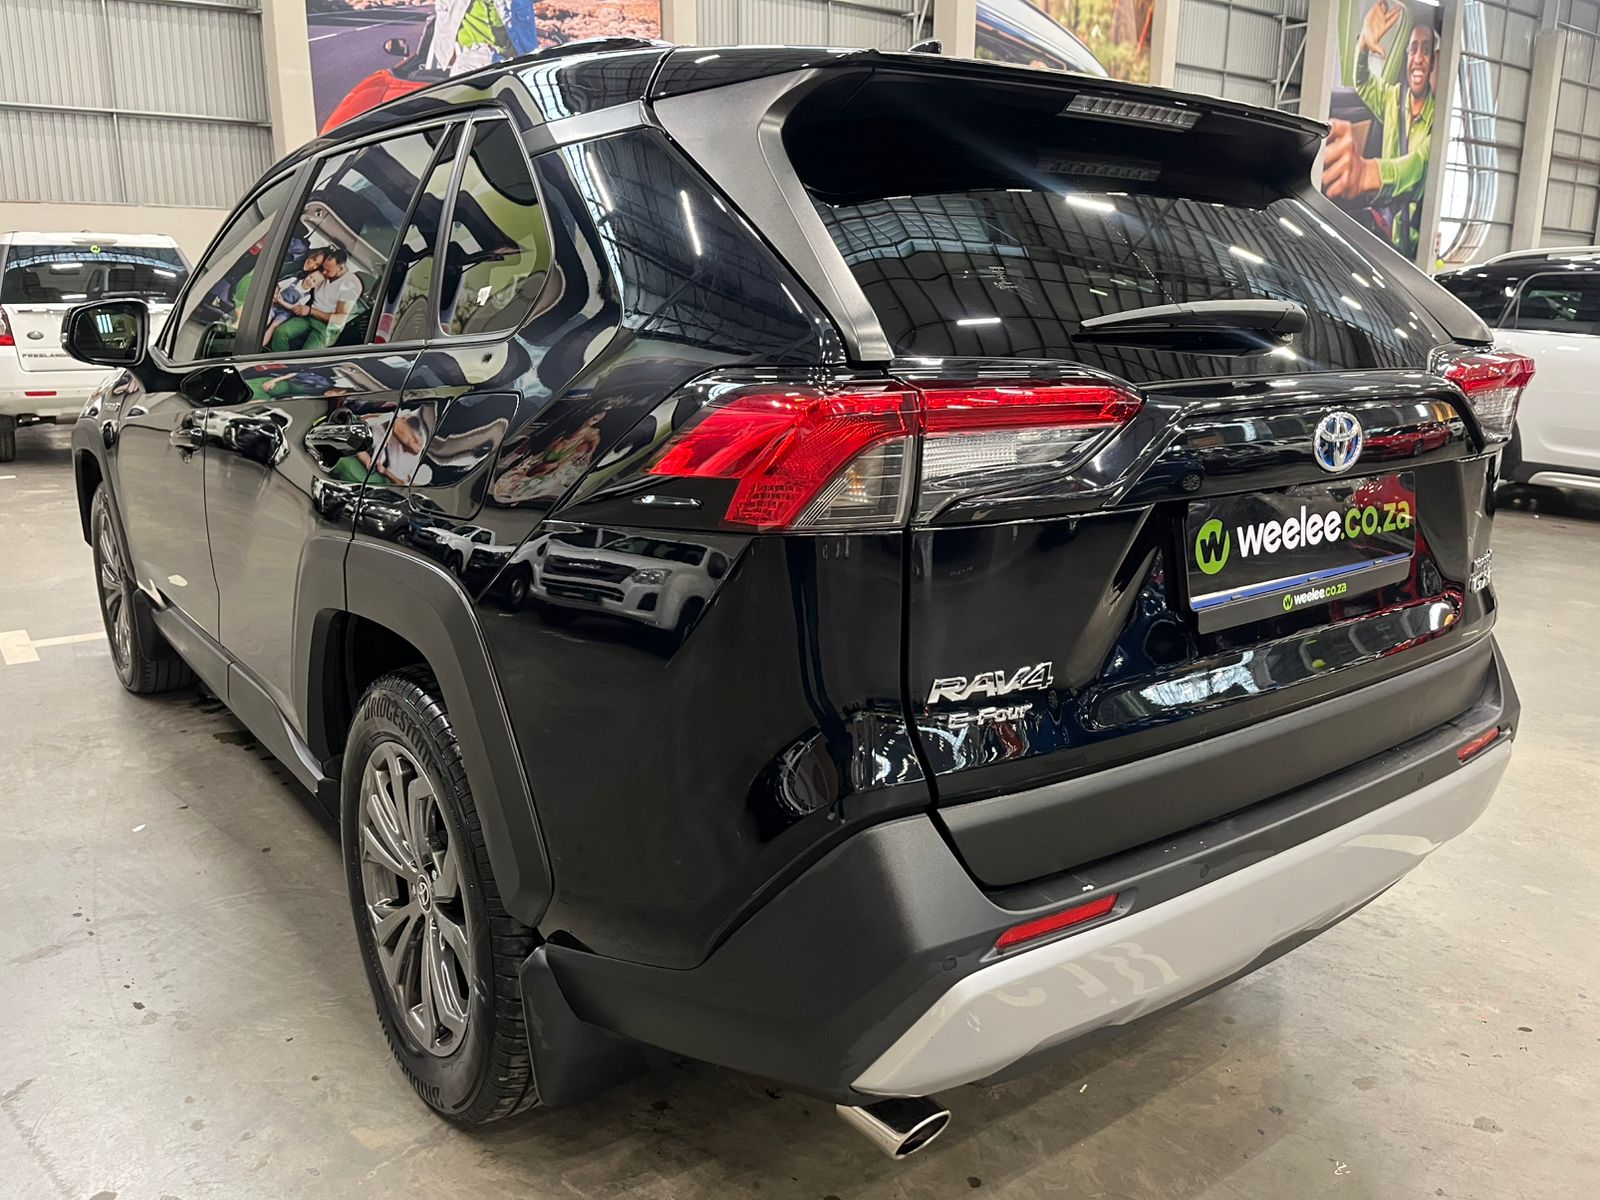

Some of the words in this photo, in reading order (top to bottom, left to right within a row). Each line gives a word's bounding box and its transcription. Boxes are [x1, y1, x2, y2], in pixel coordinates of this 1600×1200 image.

[1237, 500, 1411, 558] weelee.co.za
[1294, 582, 1347, 606] weelee.co.za
[927, 661, 1054, 704] RAV4
